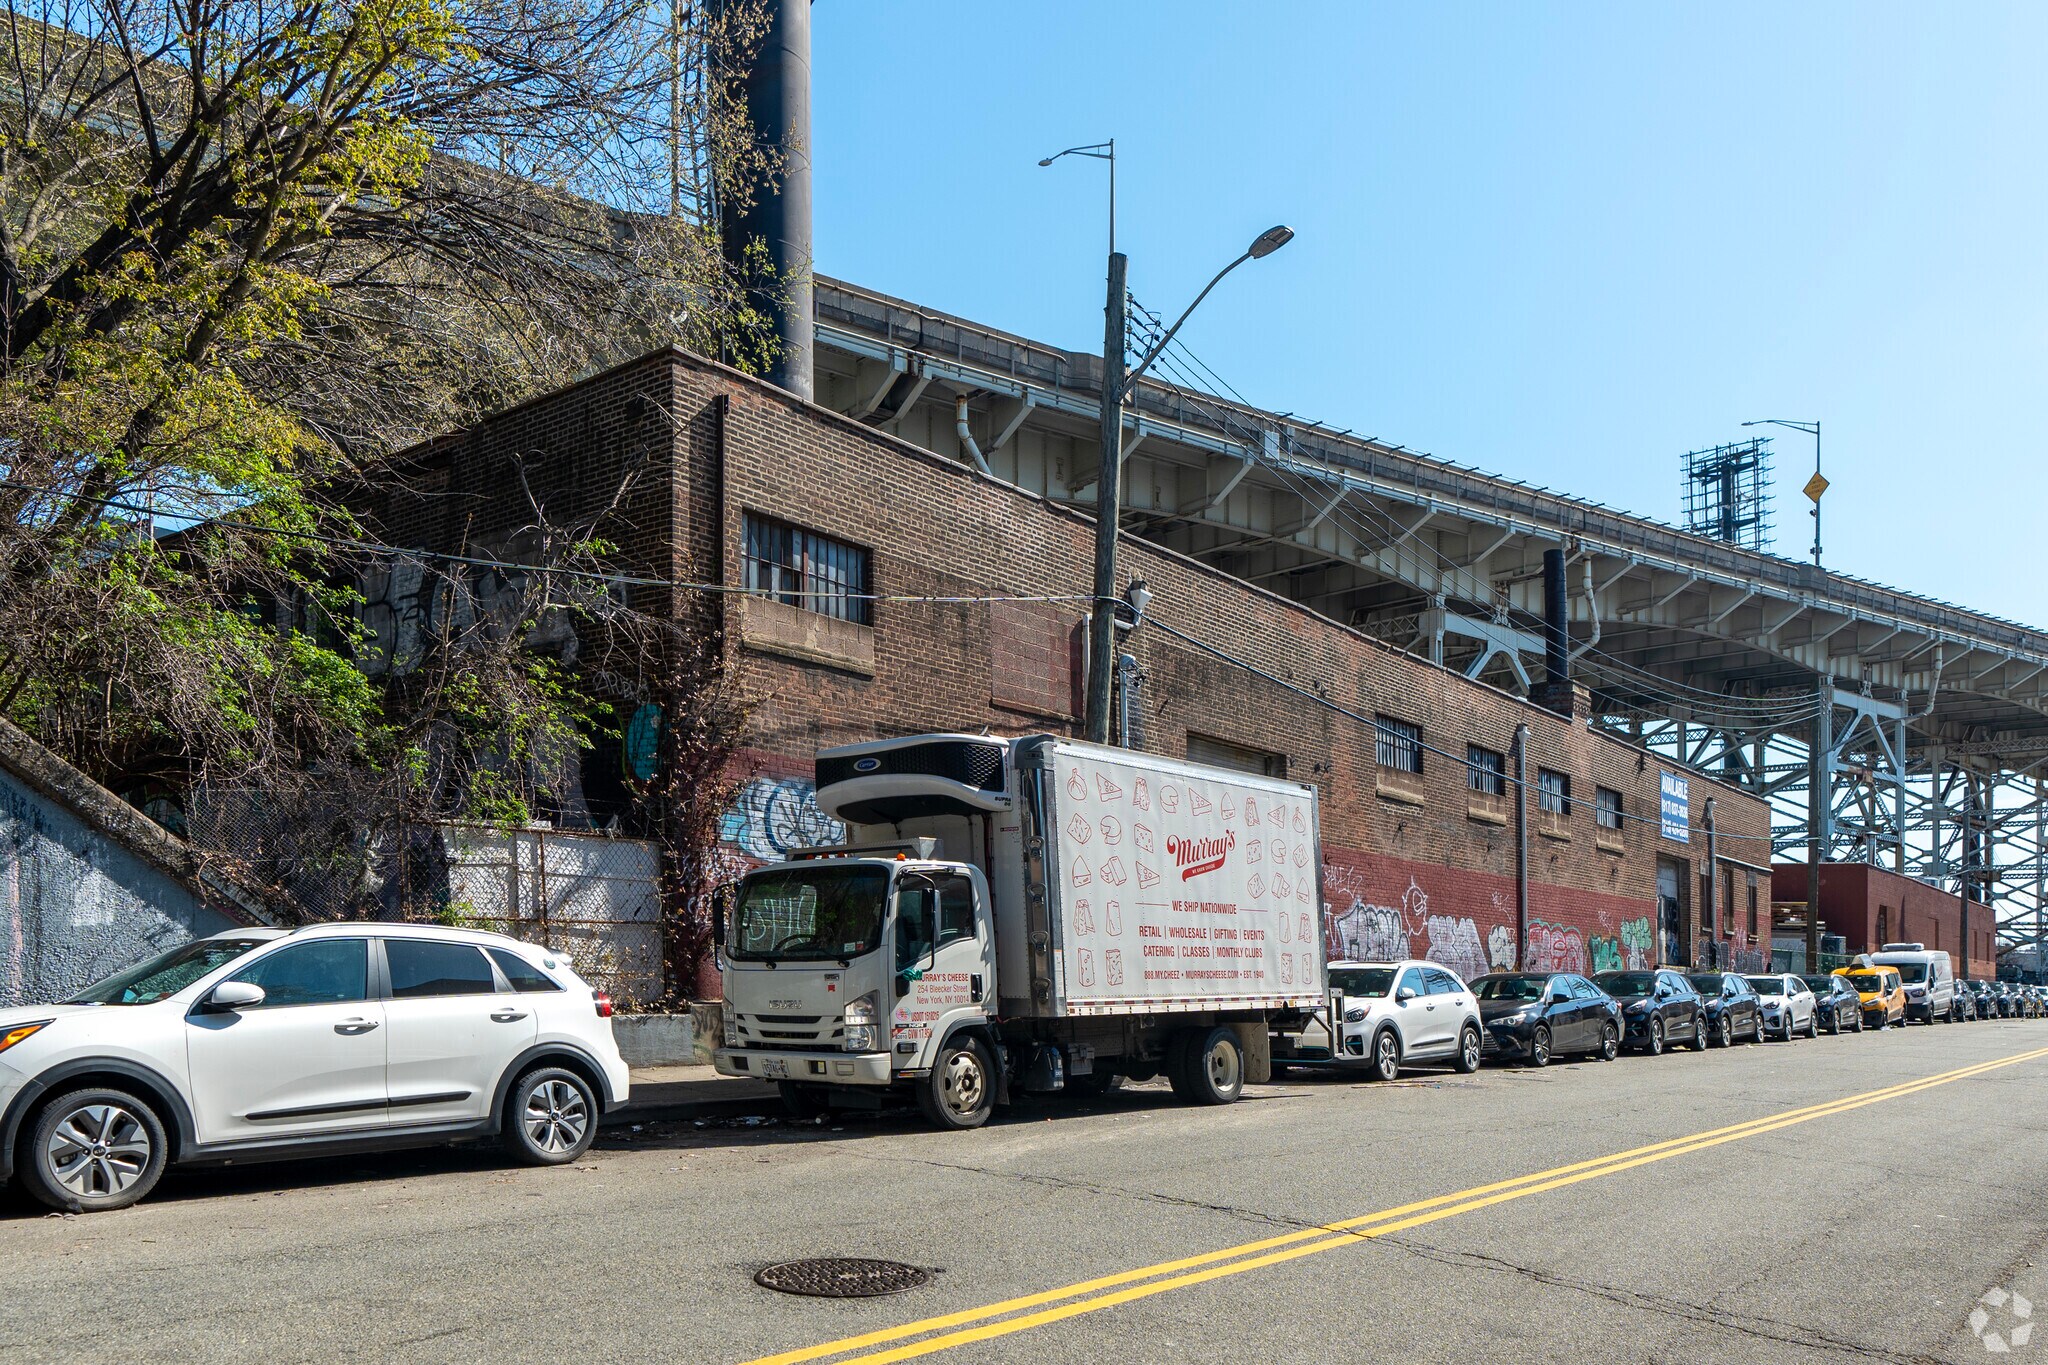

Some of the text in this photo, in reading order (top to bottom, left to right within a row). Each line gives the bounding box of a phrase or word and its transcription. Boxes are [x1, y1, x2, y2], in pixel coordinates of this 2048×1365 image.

[1662, 774, 1688, 801] AVAILABLE
[1167, 829, 1235, 868] Murray's
[1172, 900, 1237, 914] WE SHIP NATIONWIDE
[1139, 925, 1264, 940] RETAIL WHOLESALE GIFTING EVENTS
[1143, 945, 1263, 958] CATERING CLASSES MONTHLY CLUBS
[916, 973, 969, 982] URRAY'S CHEESE
[1185, 970, 1239, 979] MURRAYSCHEESE.COM
[917, 984, 968, 993] 254 Bleecker Street
[768, 999, 802, 1009] ISUZU
[916, 996, 928, 1004] New
[945, 996, 953, 1004] NY
[954, 995, 969, 1004] 10014
